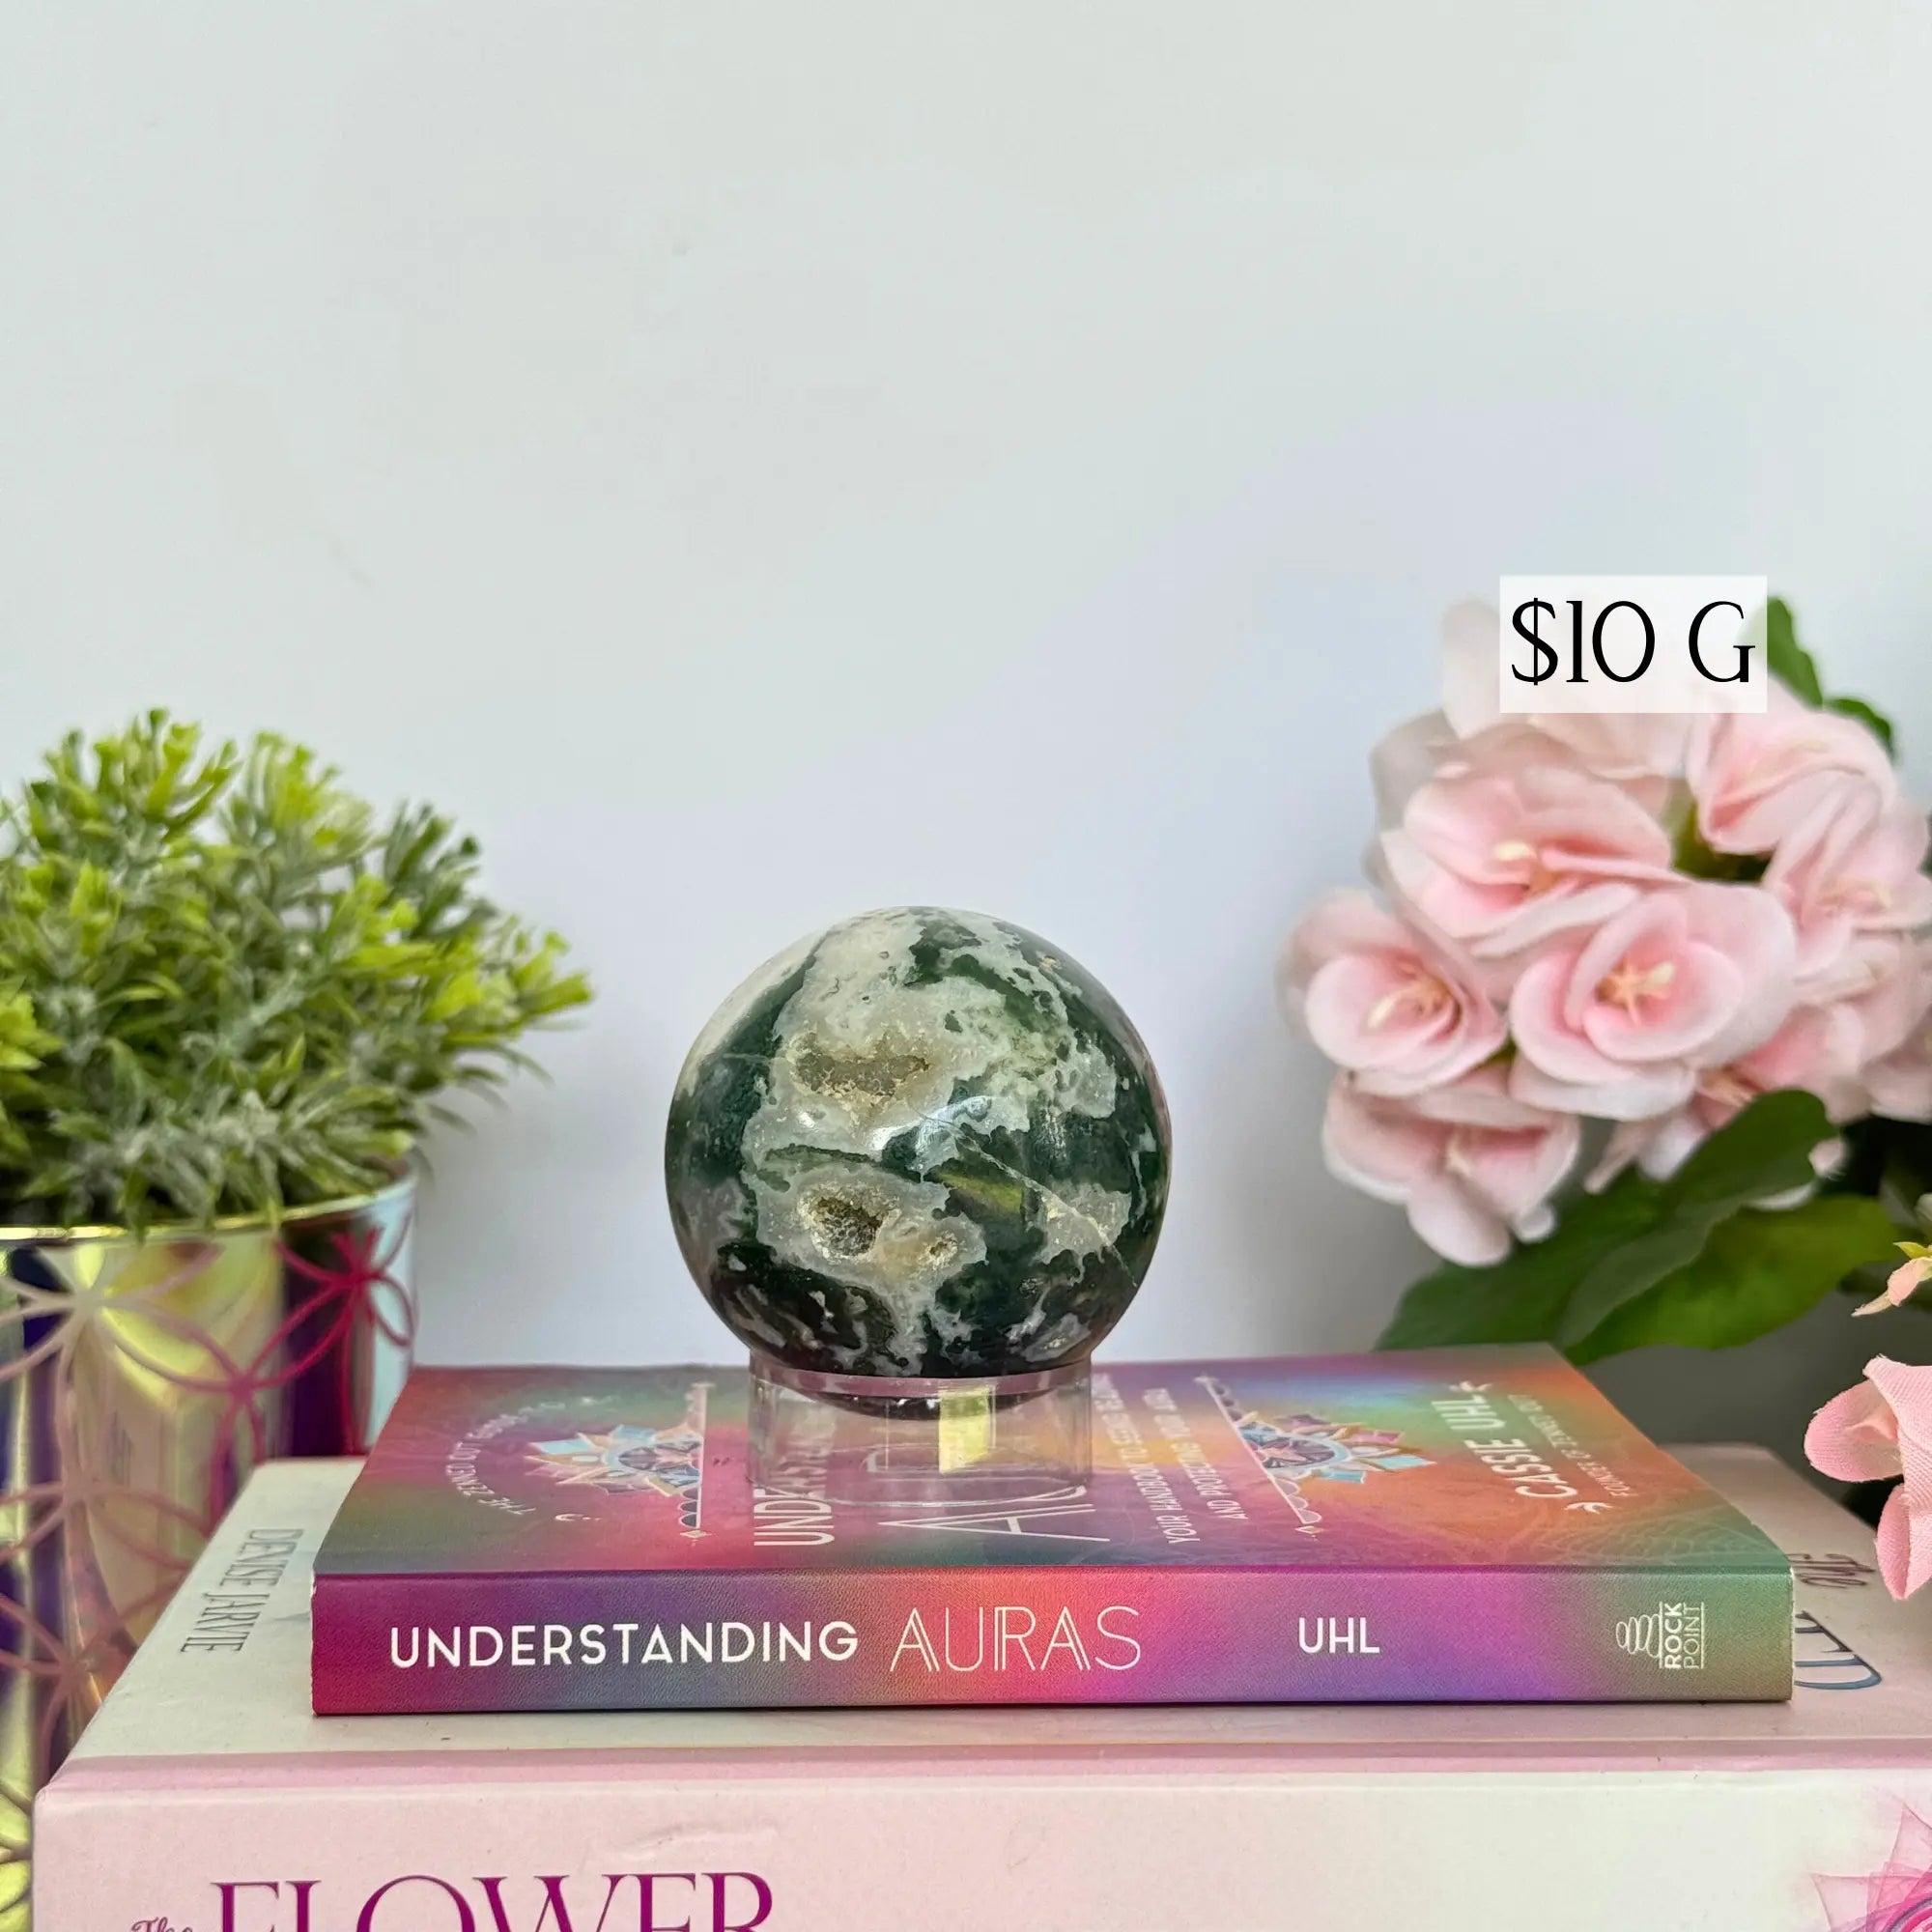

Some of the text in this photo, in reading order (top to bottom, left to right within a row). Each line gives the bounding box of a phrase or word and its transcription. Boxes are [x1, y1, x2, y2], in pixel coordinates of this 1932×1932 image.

[1431, 1395, 1578, 1498] CASSIE UHL
[1155, 1515, 1201, 1544] YOUR
[1207, 1499, 1249, 1520] AND
[180, 1528, 304, 1653] DENISE JARVIE
[389, 1605, 1142, 1673] UNDERSTANDING AURAS
[1298, 1617, 1380, 1654] UHL
[1664, 1602, 1682, 1669] ROCK
[1683, 1602, 1700, 1669] POINT
